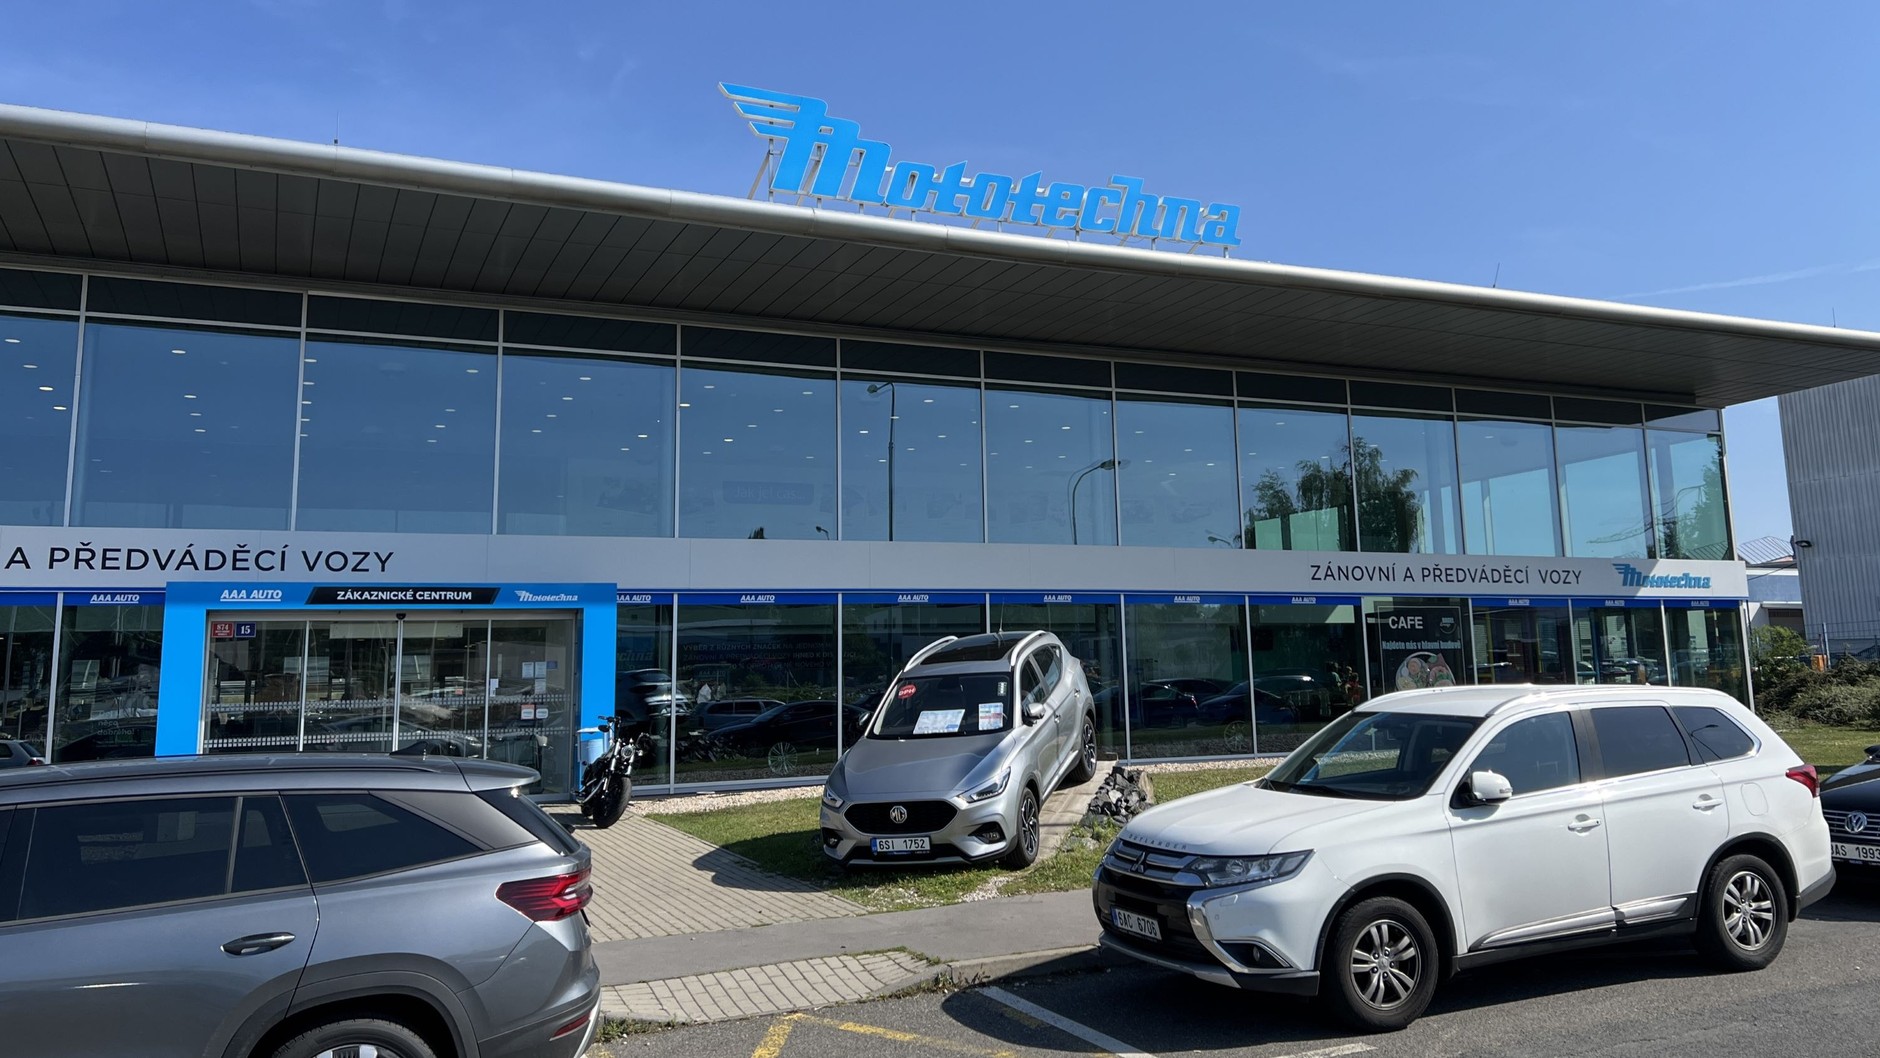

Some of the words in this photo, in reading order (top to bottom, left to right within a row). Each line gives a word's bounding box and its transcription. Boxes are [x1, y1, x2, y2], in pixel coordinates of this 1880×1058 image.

[718, 82, 1241, 247] Mototechna
[4, 546, 31, 570] A
[48, 541, 289, 572] PŘEDVÁDĚCÍ
[301, 550, 394, 573] VOZY
[1310, 561, 1396, 582] ZÁNOVNÍ
[1403, 566, 1415, 582] A
[1421, 563, 1530, 584] PŘEDVÁDĚCÍ
[1538, 569, 1582, 585] VOZY
[1612, 563, 1712, 589] Mototechna
[90, 594, 112, 602] AAA
[113, 594, 140, 602] AUTO
[220, 590, 247, 599] AAA
[250, 589, 282, 599] AUTO
[336, 589, 413, 601] ZÁKAZNICKÉ
[416, 591, 472, 600] CENTRUM
[514, 590, 578, 602] Mototechna
[740, 594, 755, 602] AAA
[757, 594, 776, 602] AUTO
[240, 625, 251, 635] 15
[1388, 616, 1424, 630] CAFE
[891, 808, 906, 822] MG
[878, 840, 895, 850] 6SI
[903, 839, 925, 850] 1752
[1855, 846, 1880, 860] 1993
[1117, 911, 1133, 929] 6AC
[1137, 916, 1157, 936] 6706
